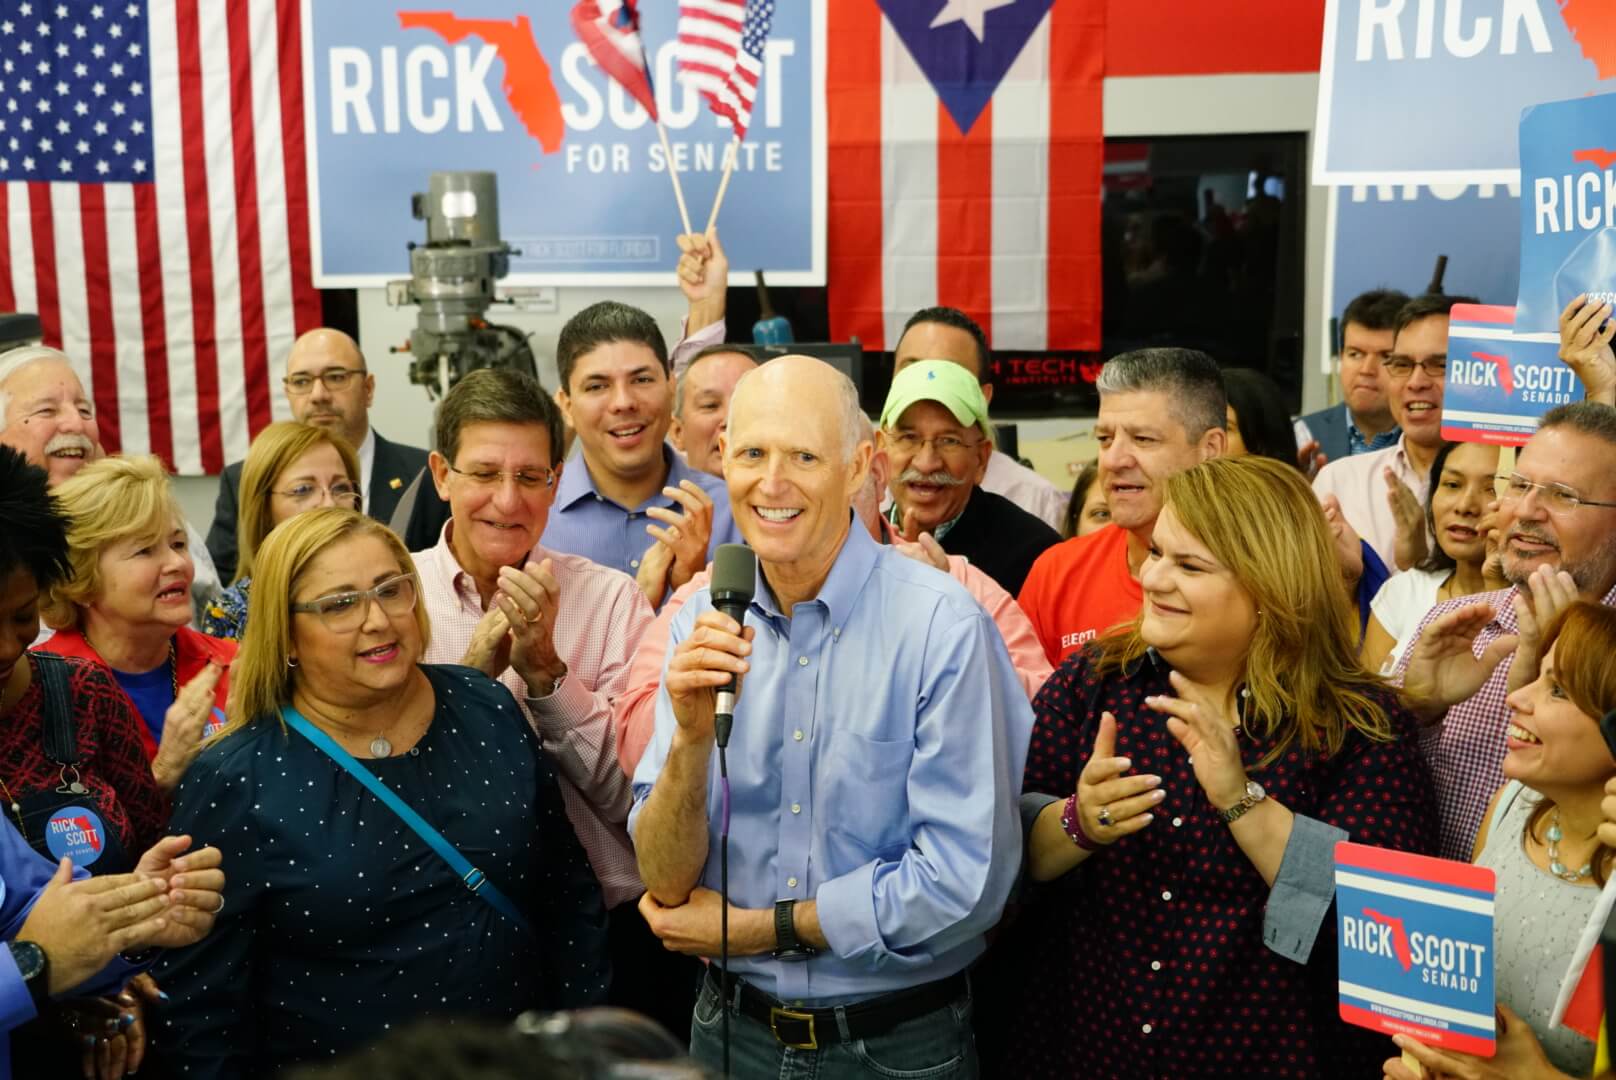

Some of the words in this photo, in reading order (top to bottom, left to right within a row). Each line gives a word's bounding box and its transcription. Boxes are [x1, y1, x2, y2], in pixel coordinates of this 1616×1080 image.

[1355, 0, 1553, 61] RICK
[329, 44, 504, 134] RICK
[567, 143, 629, 173] FOR
[648, 142, 783, 173] SENATE
[1008, 359, 1076, 375] TECH
[1451, 359, 1498, 387] RICK
[1512, 364, 1576, 393] SCOTT
[1522, 391, 1571, 404] SENADO
[51, 817, 77, 834] RICK
[66, 828, 97, 846] SCOTT
[1343, 915, 1393, 958] RICK
[1410, 931, 1486, 978] SCOTT
[1422, 967, 1478, 994] SENADO
